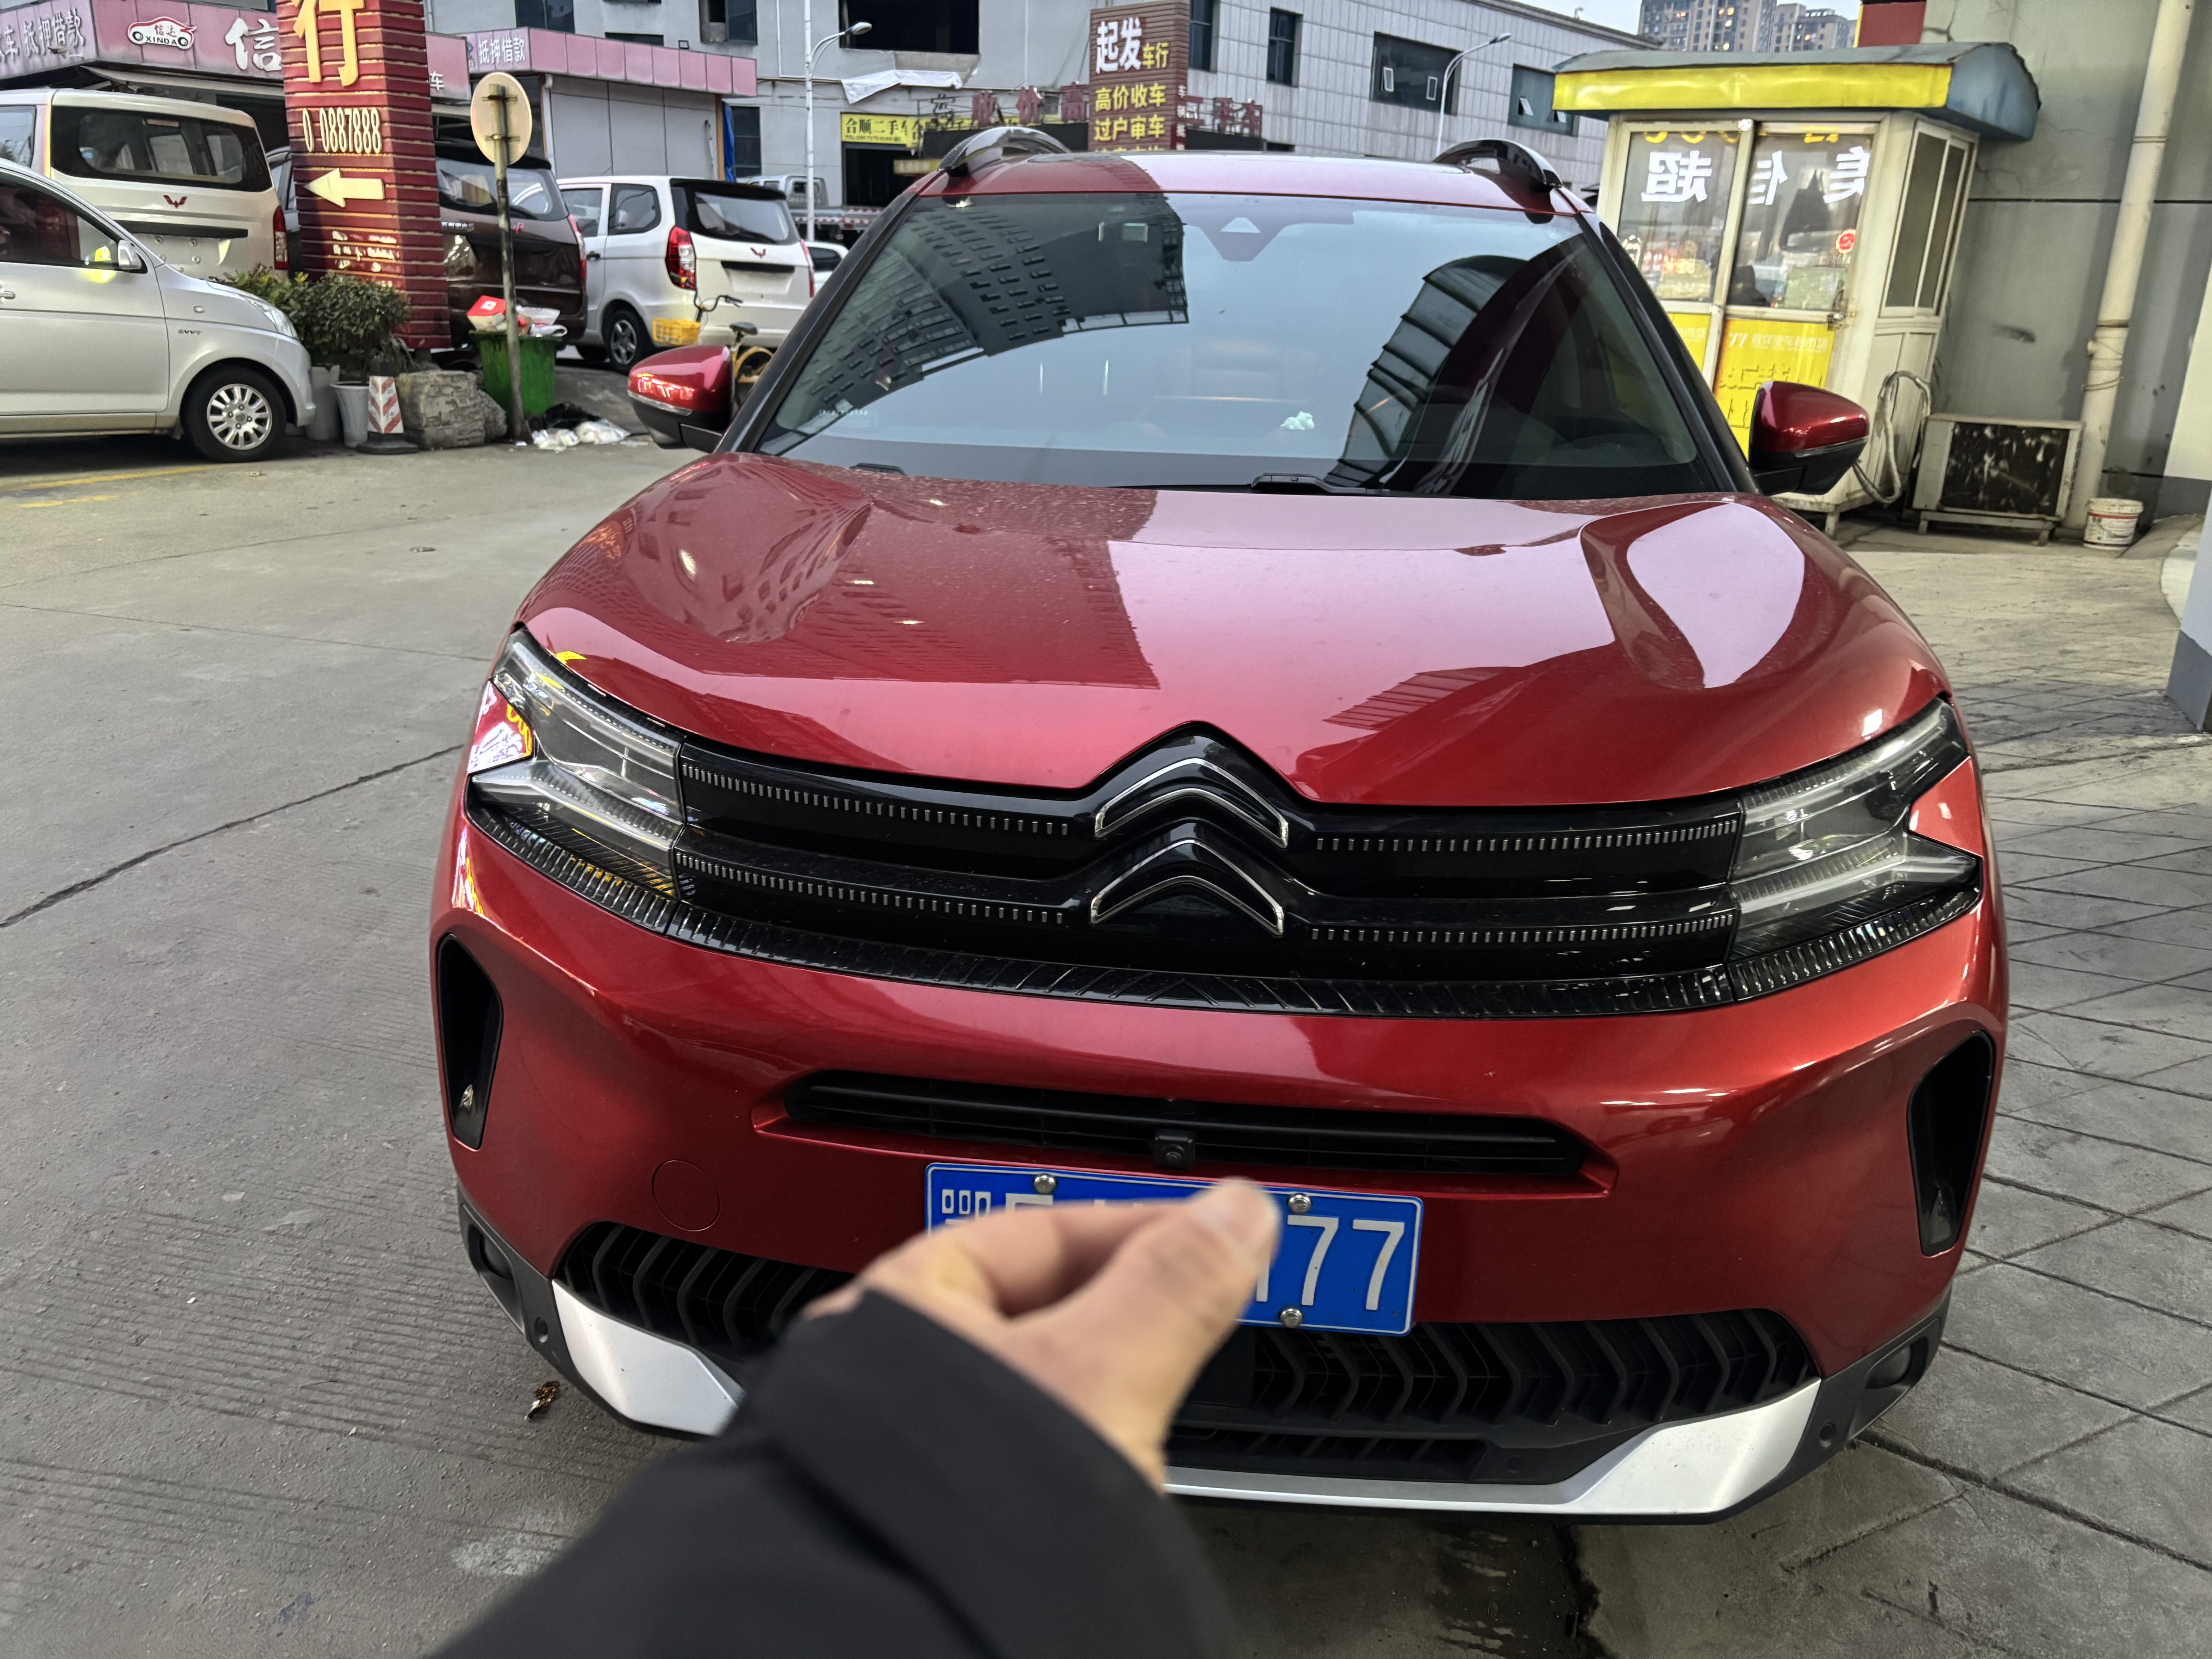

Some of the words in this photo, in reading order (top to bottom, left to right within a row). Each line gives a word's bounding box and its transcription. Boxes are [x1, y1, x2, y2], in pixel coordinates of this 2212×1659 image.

[146, 36, 177, 45] XINDA
[225, 18, 282, 72] 信
[479, 36, 525, 64] 抵押借款
[1095, 83, 1166, 112] 高价收车
[319, 107, 382, 154] 0887888
[1094, 114, 1165, 141] 过户审车
